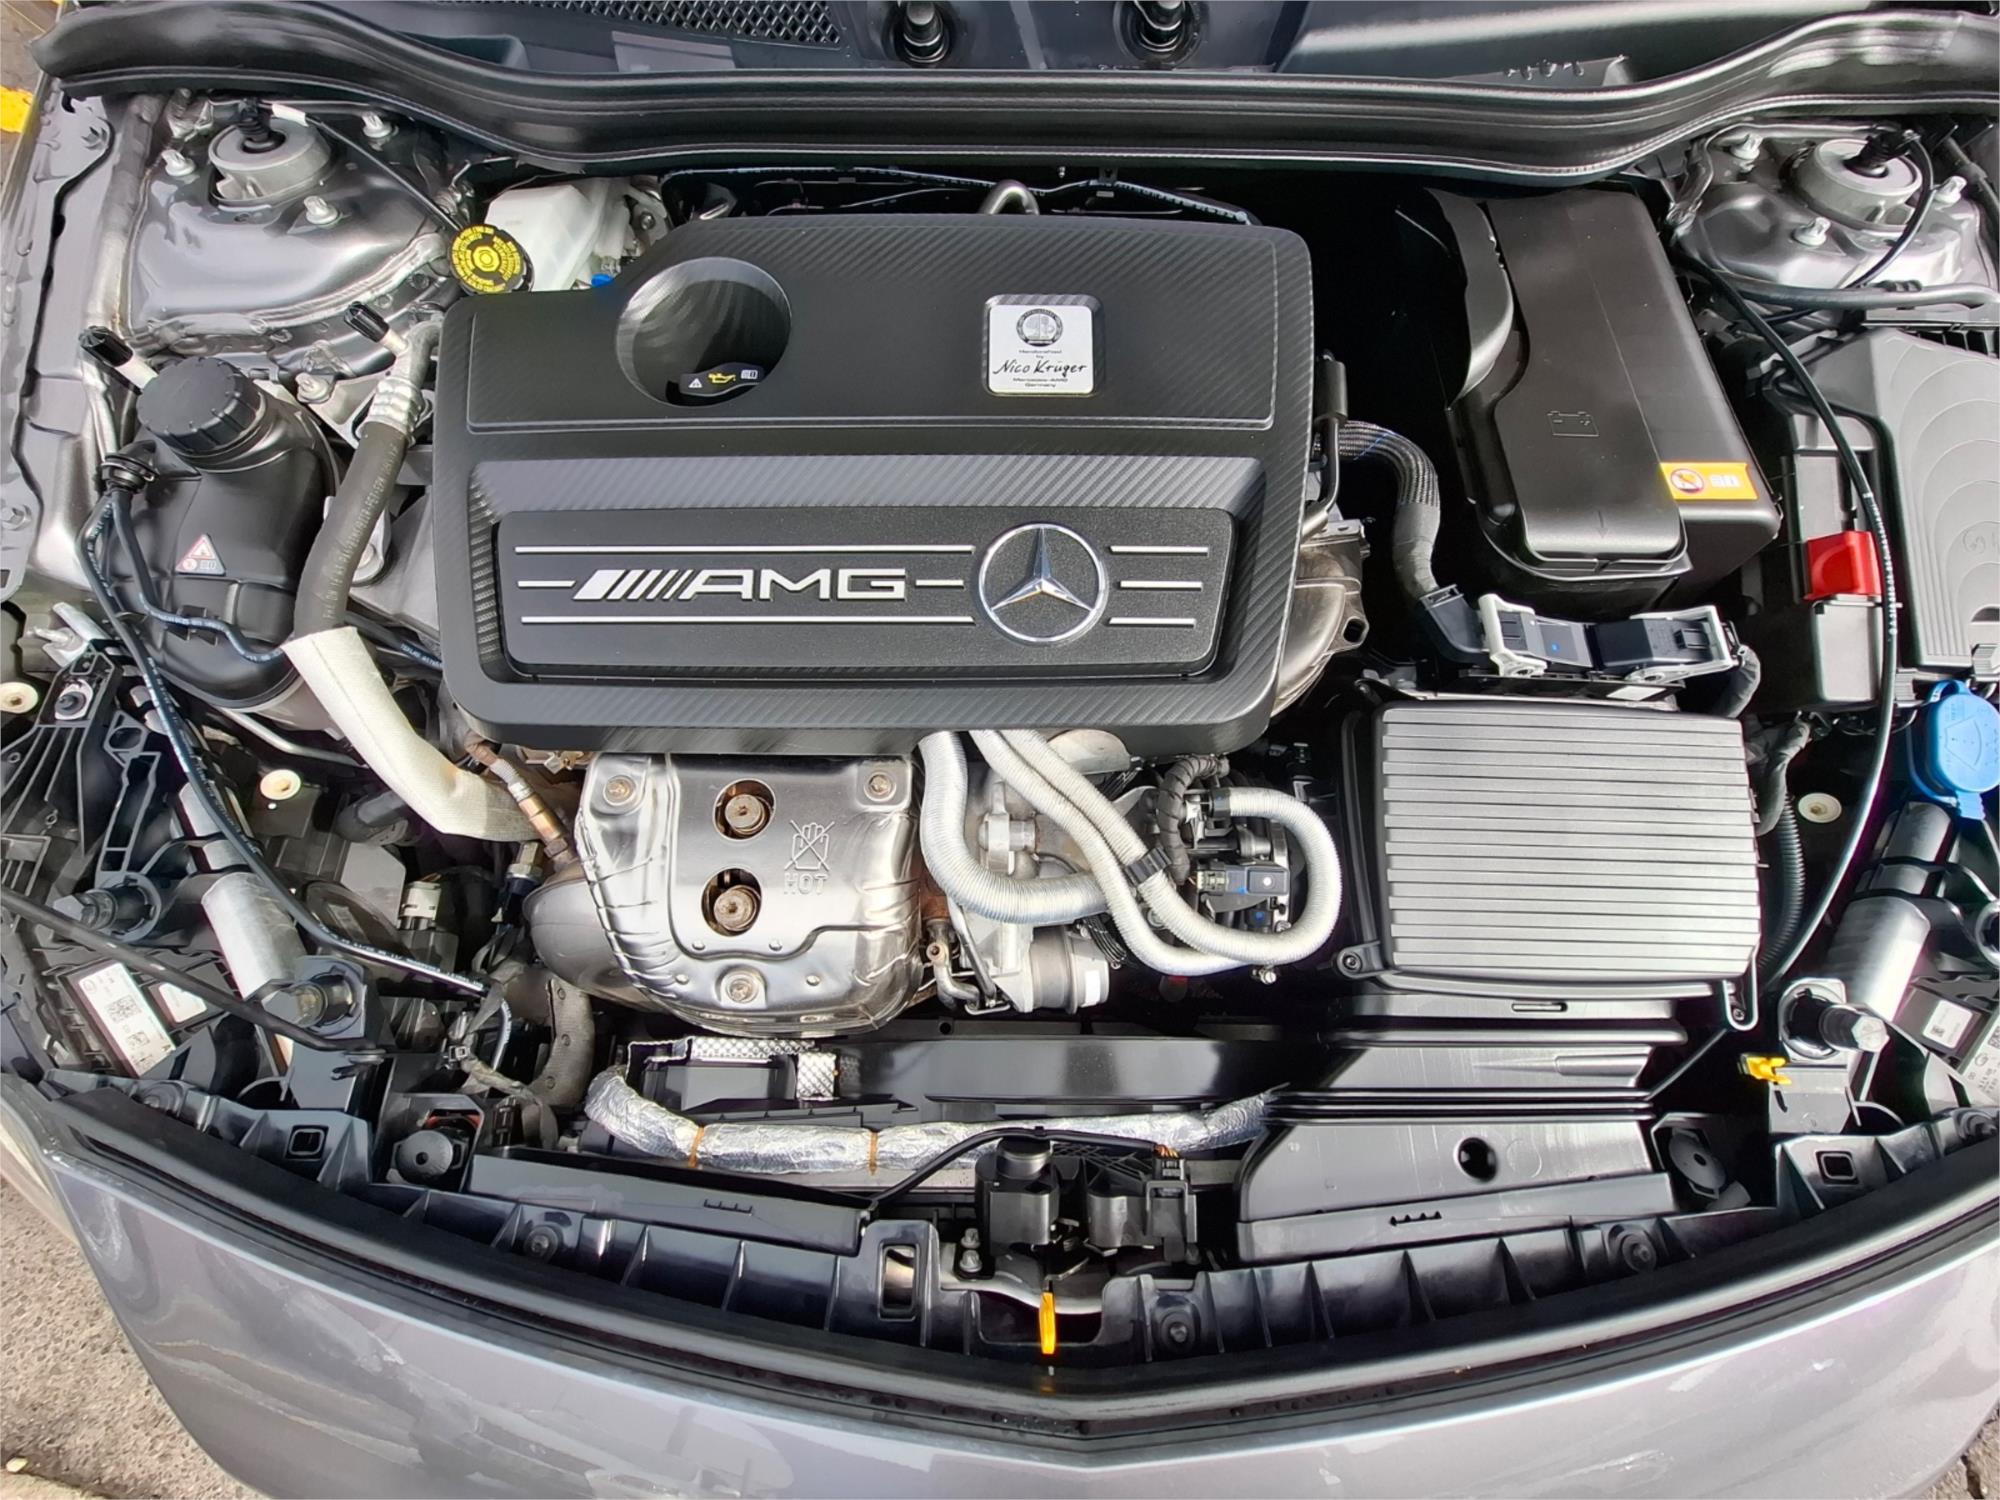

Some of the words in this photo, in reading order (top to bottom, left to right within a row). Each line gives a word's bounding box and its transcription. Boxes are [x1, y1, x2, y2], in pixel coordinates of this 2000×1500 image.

[992, 358, 1031, 375] Nico
[1032, 359, 1088, 378] Krüger
[678, 568, 907, 600] AMG
[784, 872, 829, 896] HOT
